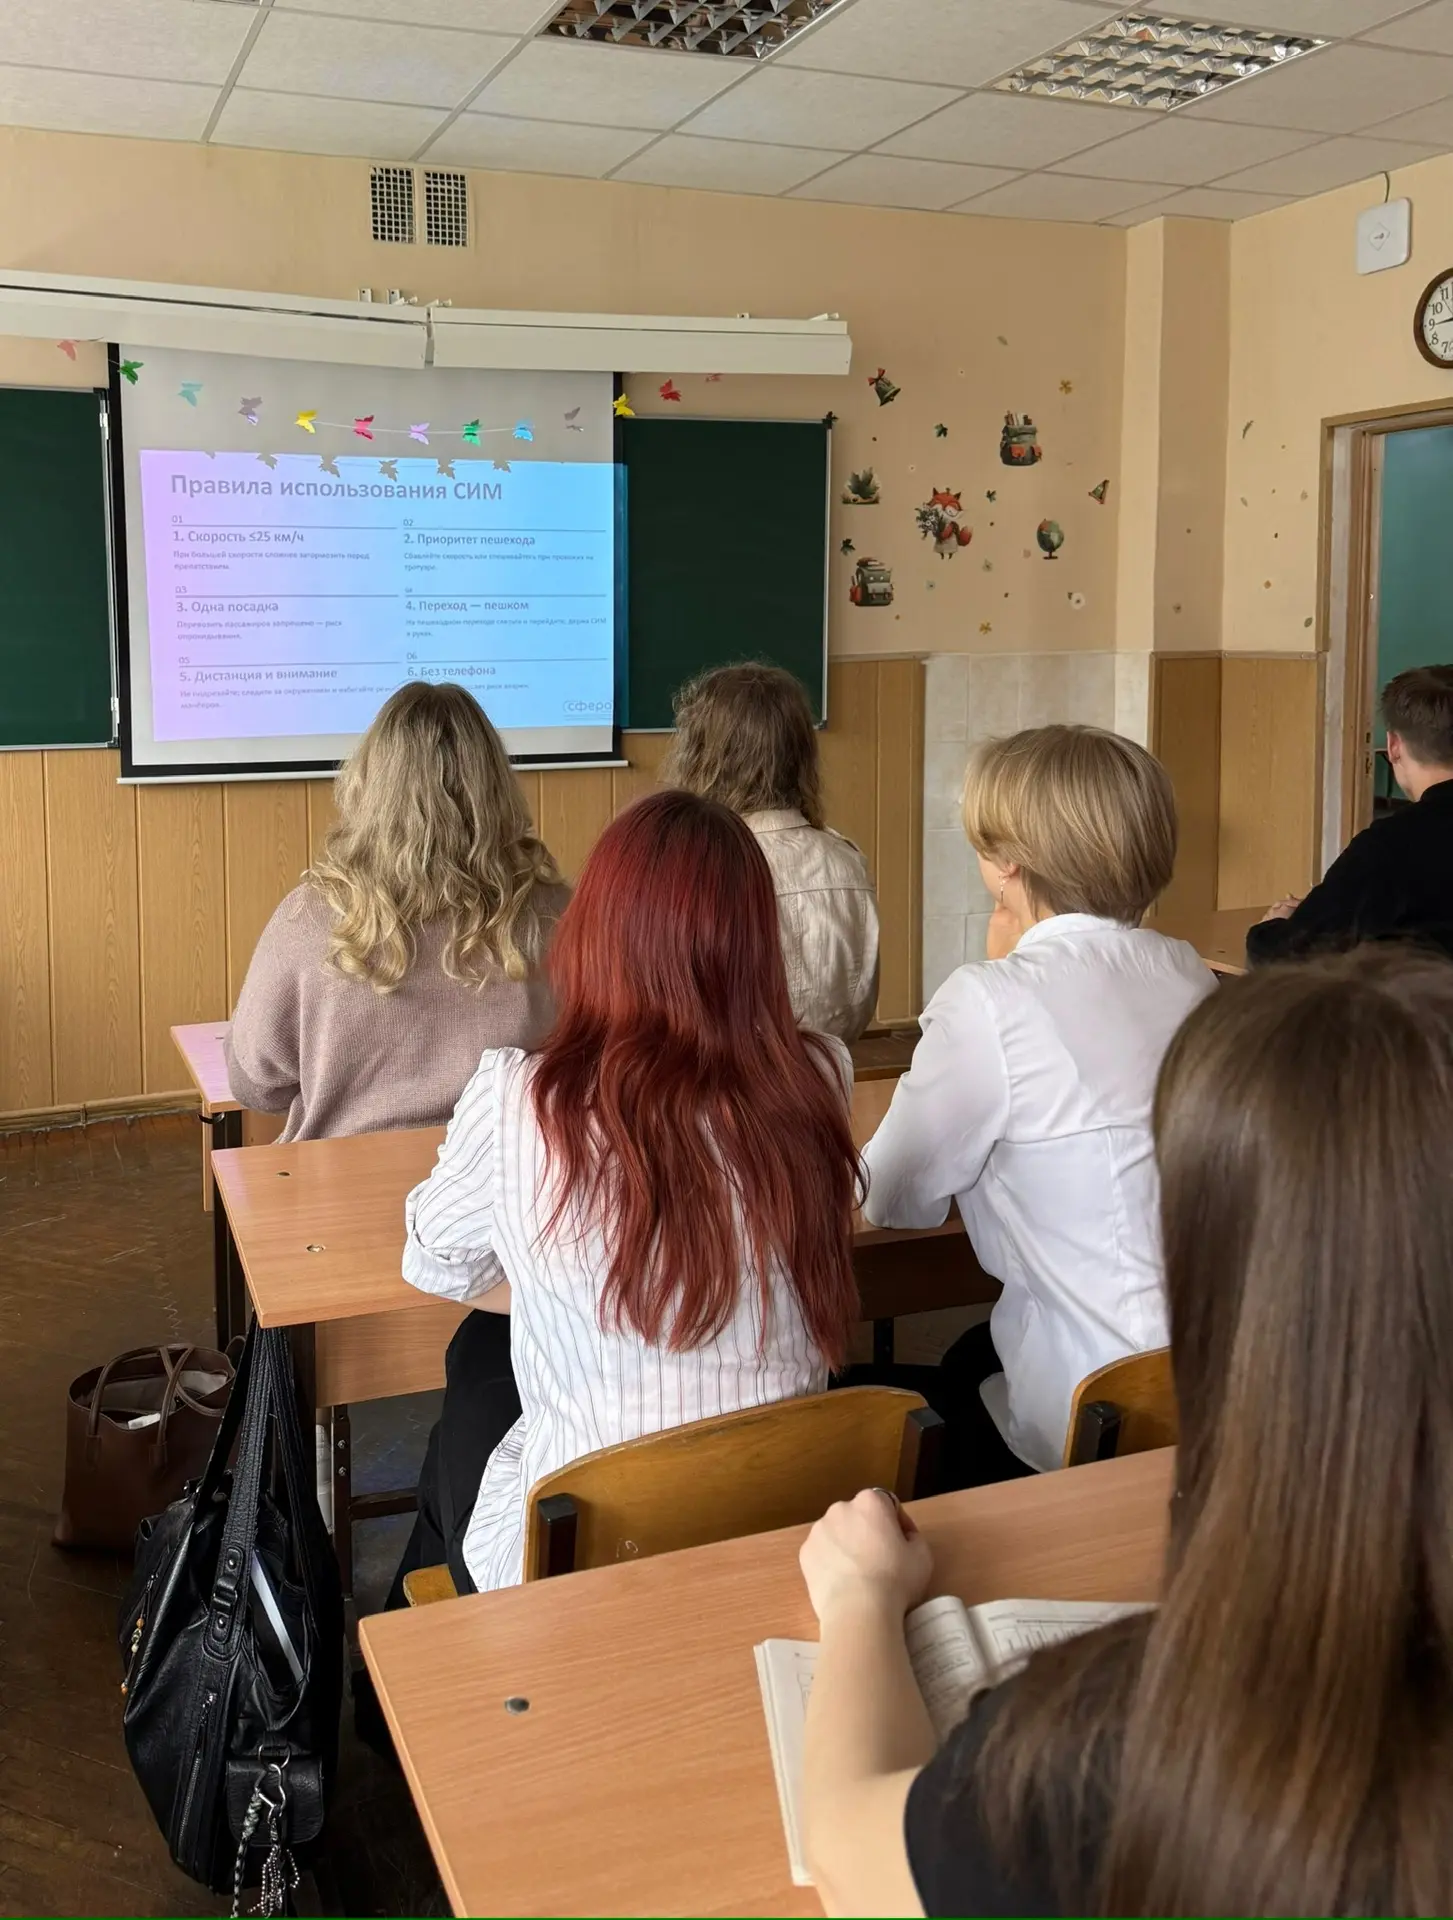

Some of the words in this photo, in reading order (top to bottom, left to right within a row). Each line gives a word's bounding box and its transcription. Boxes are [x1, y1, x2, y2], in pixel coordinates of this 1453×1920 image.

[1431, 301, 1443, 315] 10
[1429, 318, 1435, 331] 9
[1431, 332, 1439, 345] 8
[171, 474, 272, 498] Правила
[280, 480, 447, 499] использования
[454, 482, 502, 500] СИМ
[171, 514, 183, 524] 01
[403, 518, 414, 527] 02
[173, 531, 184, 542] 1.
[188, 530, 246, 544] Скорость
[249, 531, 271, 542] ≤25
[274, 530, 304, 544] км/ч
[404, 533, 415, 545] 2.
[417, 533, 478, 547] Приоритет
[480, 536, 536, 547] пешехода
[176, 601, 188, 613] 3.
[191, 601, 224, 613] Одна
[228, 602, 279, 613] посадка
[406, 600, 416, 611] 4.
[419, 601, 467, 612] Переход
[484, 602, 529, 611] пешком
[180, 672, 191, 683] 5.
[195, 671, 262, 683] Дистанция
[266, 672, 273, 681] и
[276, 670, 338, 680] внимание
[407, 666, 418, 677] 6.
[420, 666, 440, 677] Без
[442, 665, 496, 678] телефона
